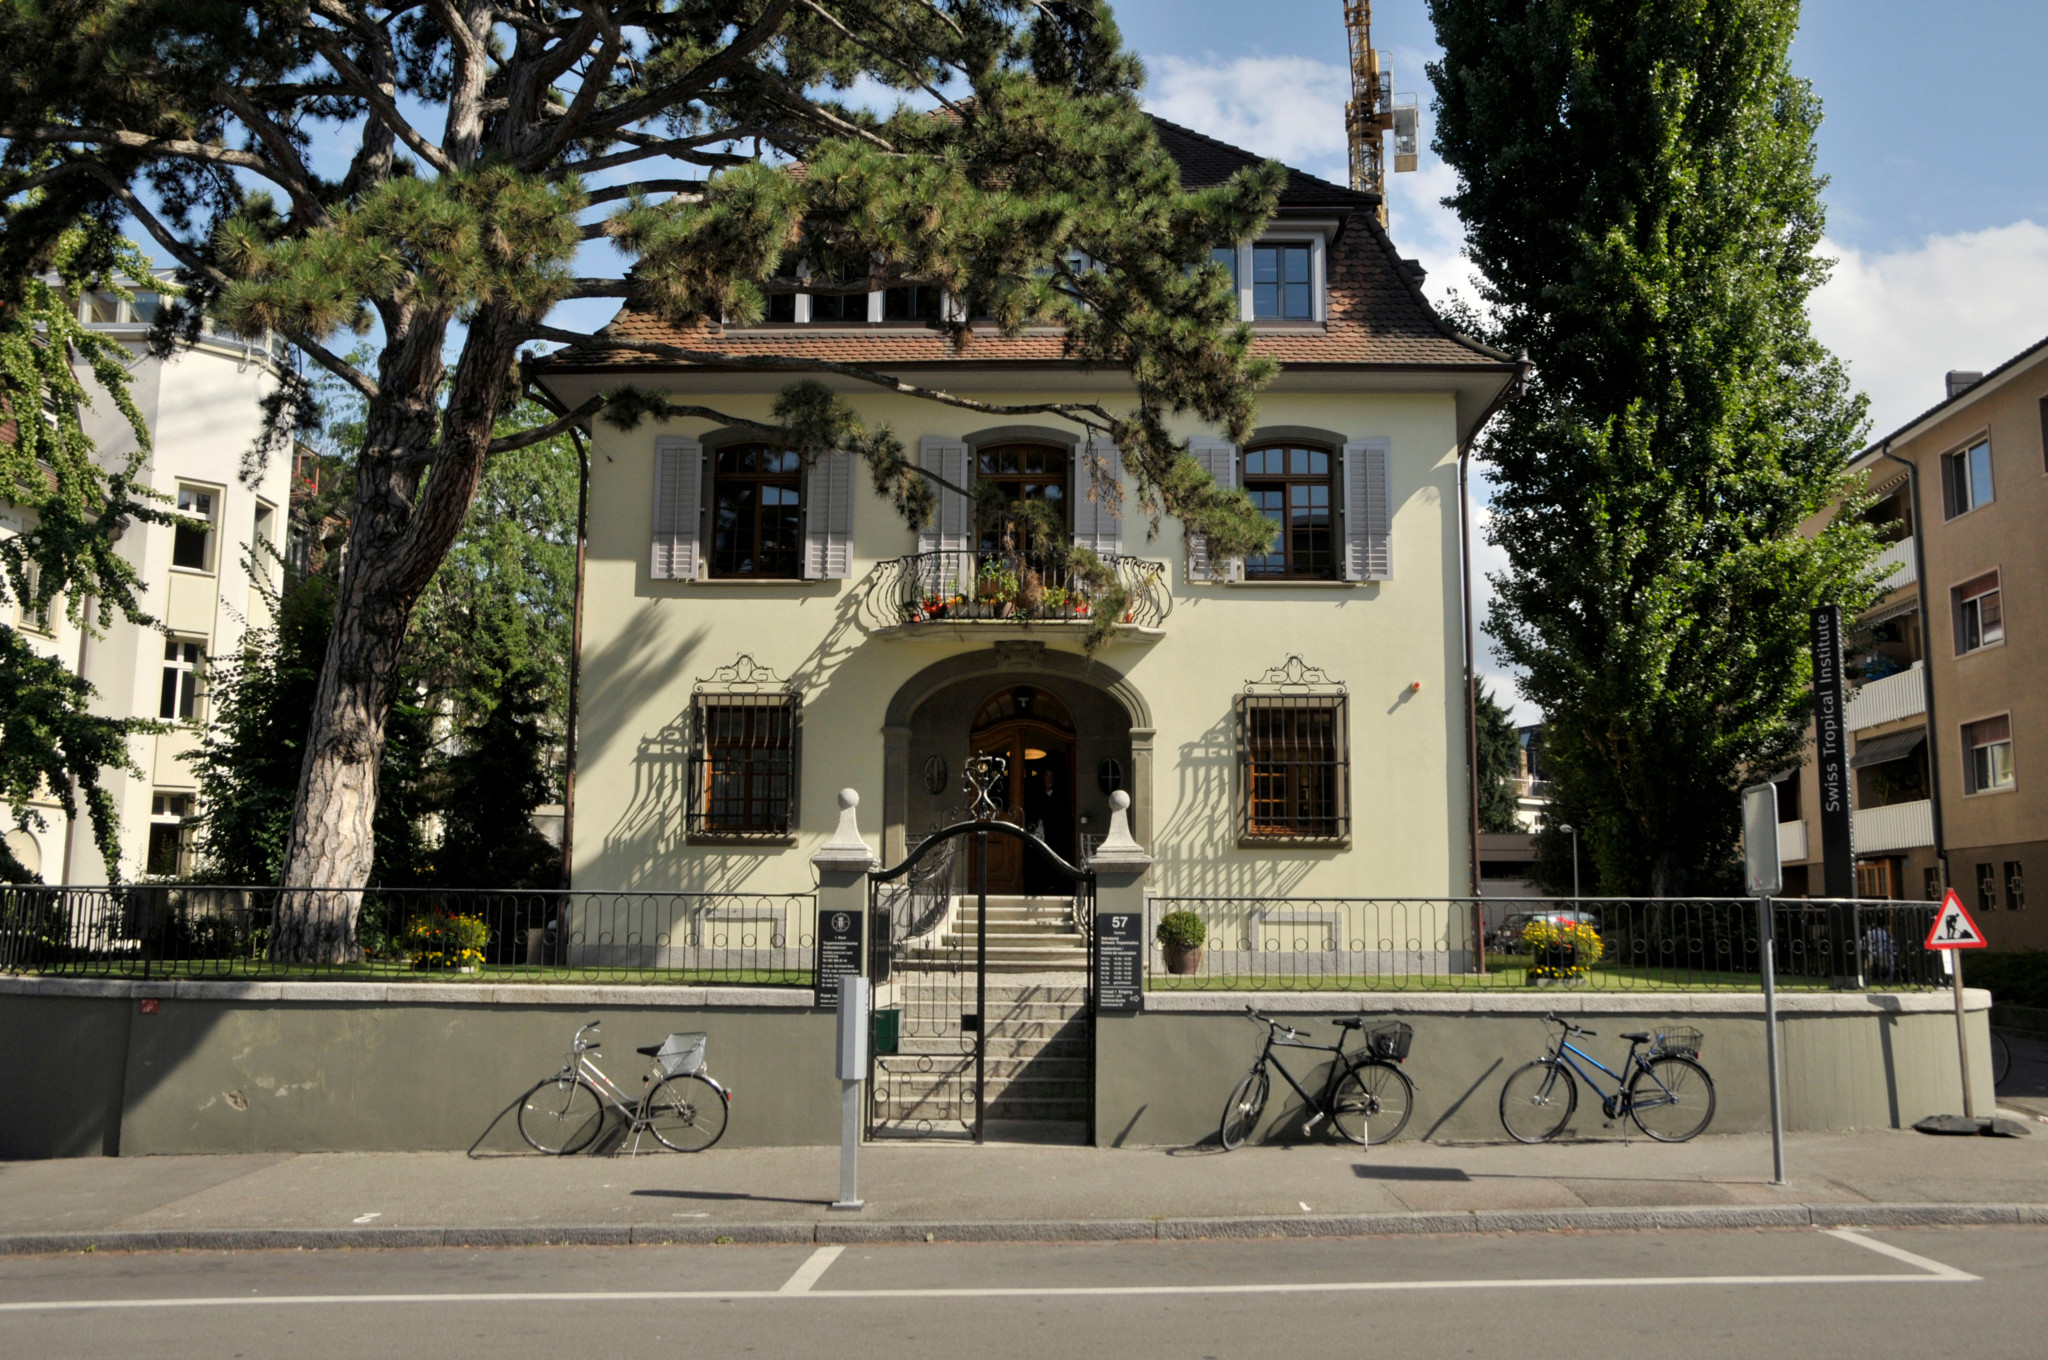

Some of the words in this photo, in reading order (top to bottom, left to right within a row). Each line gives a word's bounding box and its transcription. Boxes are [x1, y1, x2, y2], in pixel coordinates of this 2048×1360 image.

[1817, 614, 1832, 683] Institute
[1820, 690, 1838, 757] Tropical
[1825, 763, 1839, 812] Swiss
[1112, 916, 1128, 928] 57
